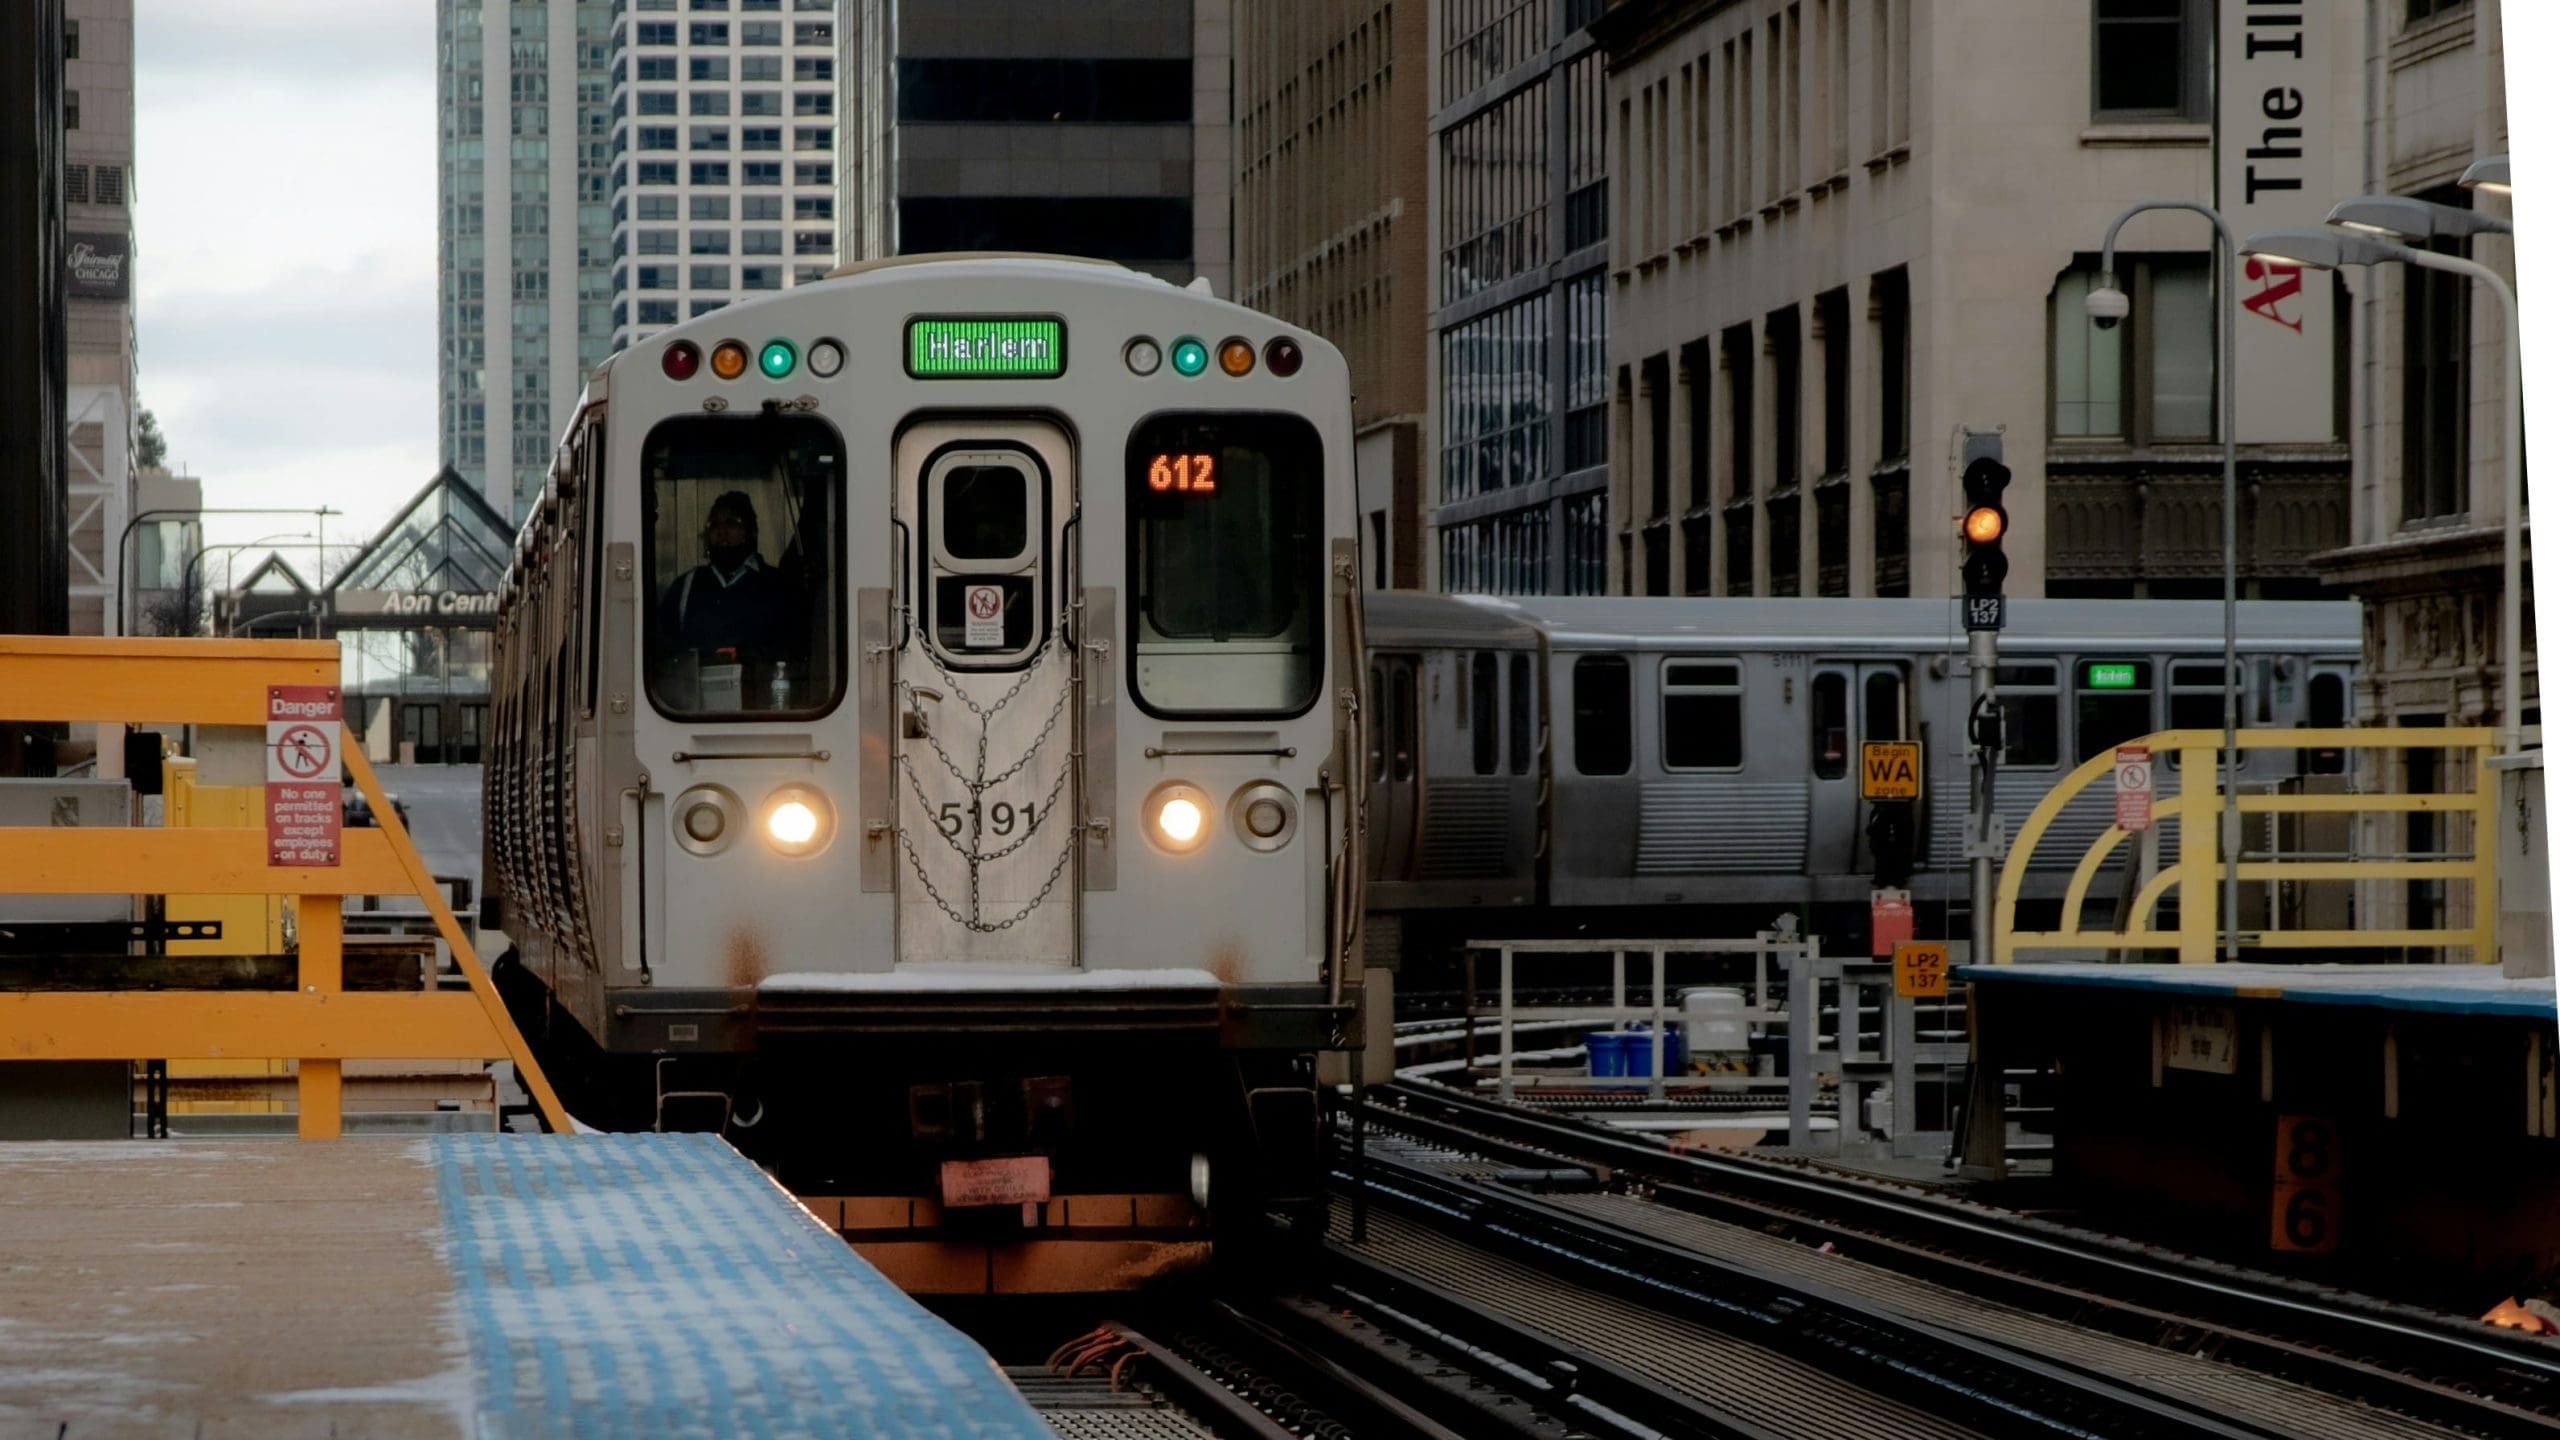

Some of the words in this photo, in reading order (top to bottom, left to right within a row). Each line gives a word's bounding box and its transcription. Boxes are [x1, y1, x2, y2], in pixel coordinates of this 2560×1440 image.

[2246, 87, 2303, 204] The
[75, 268, 119, 279] CHICAGO
[930, 331, 1048, 359] Harlem
[1150, 454, 1215, 489] 612
[382, 590, 432, 614] Aon
[437, 590, 499, 615] Cent
[1970, 598, 1999, 611] LP2
[1972, 611, 1998, 624] 137
[272, 699, 335, 717] Danger
[1872, 746, 1910, 759] Begin
[1868, 760, 1914, 782] WA
[281, 788, 298, 800] No
[303, 790, 326, 800] one
[1874, 786, 1907, 796] zone
[274, 801, 333, 814] permitted
[275, 814, 291, 824] on
[295, 813, 332, 824] tracks
[940, 802, 1035, 836] 5191
[283, 826, 325, 836] except
[274, 837, 334, 849] employees
[280, 850, 296, 860] on
[300, 849, 328, 861] duty
[1907, 953, 1939, 968] LP2
[1909, 974, 1938, 988] 137
[2288, 1120, 2331, 1179] 8
[2285, 1189, 2328, 1249] 6
